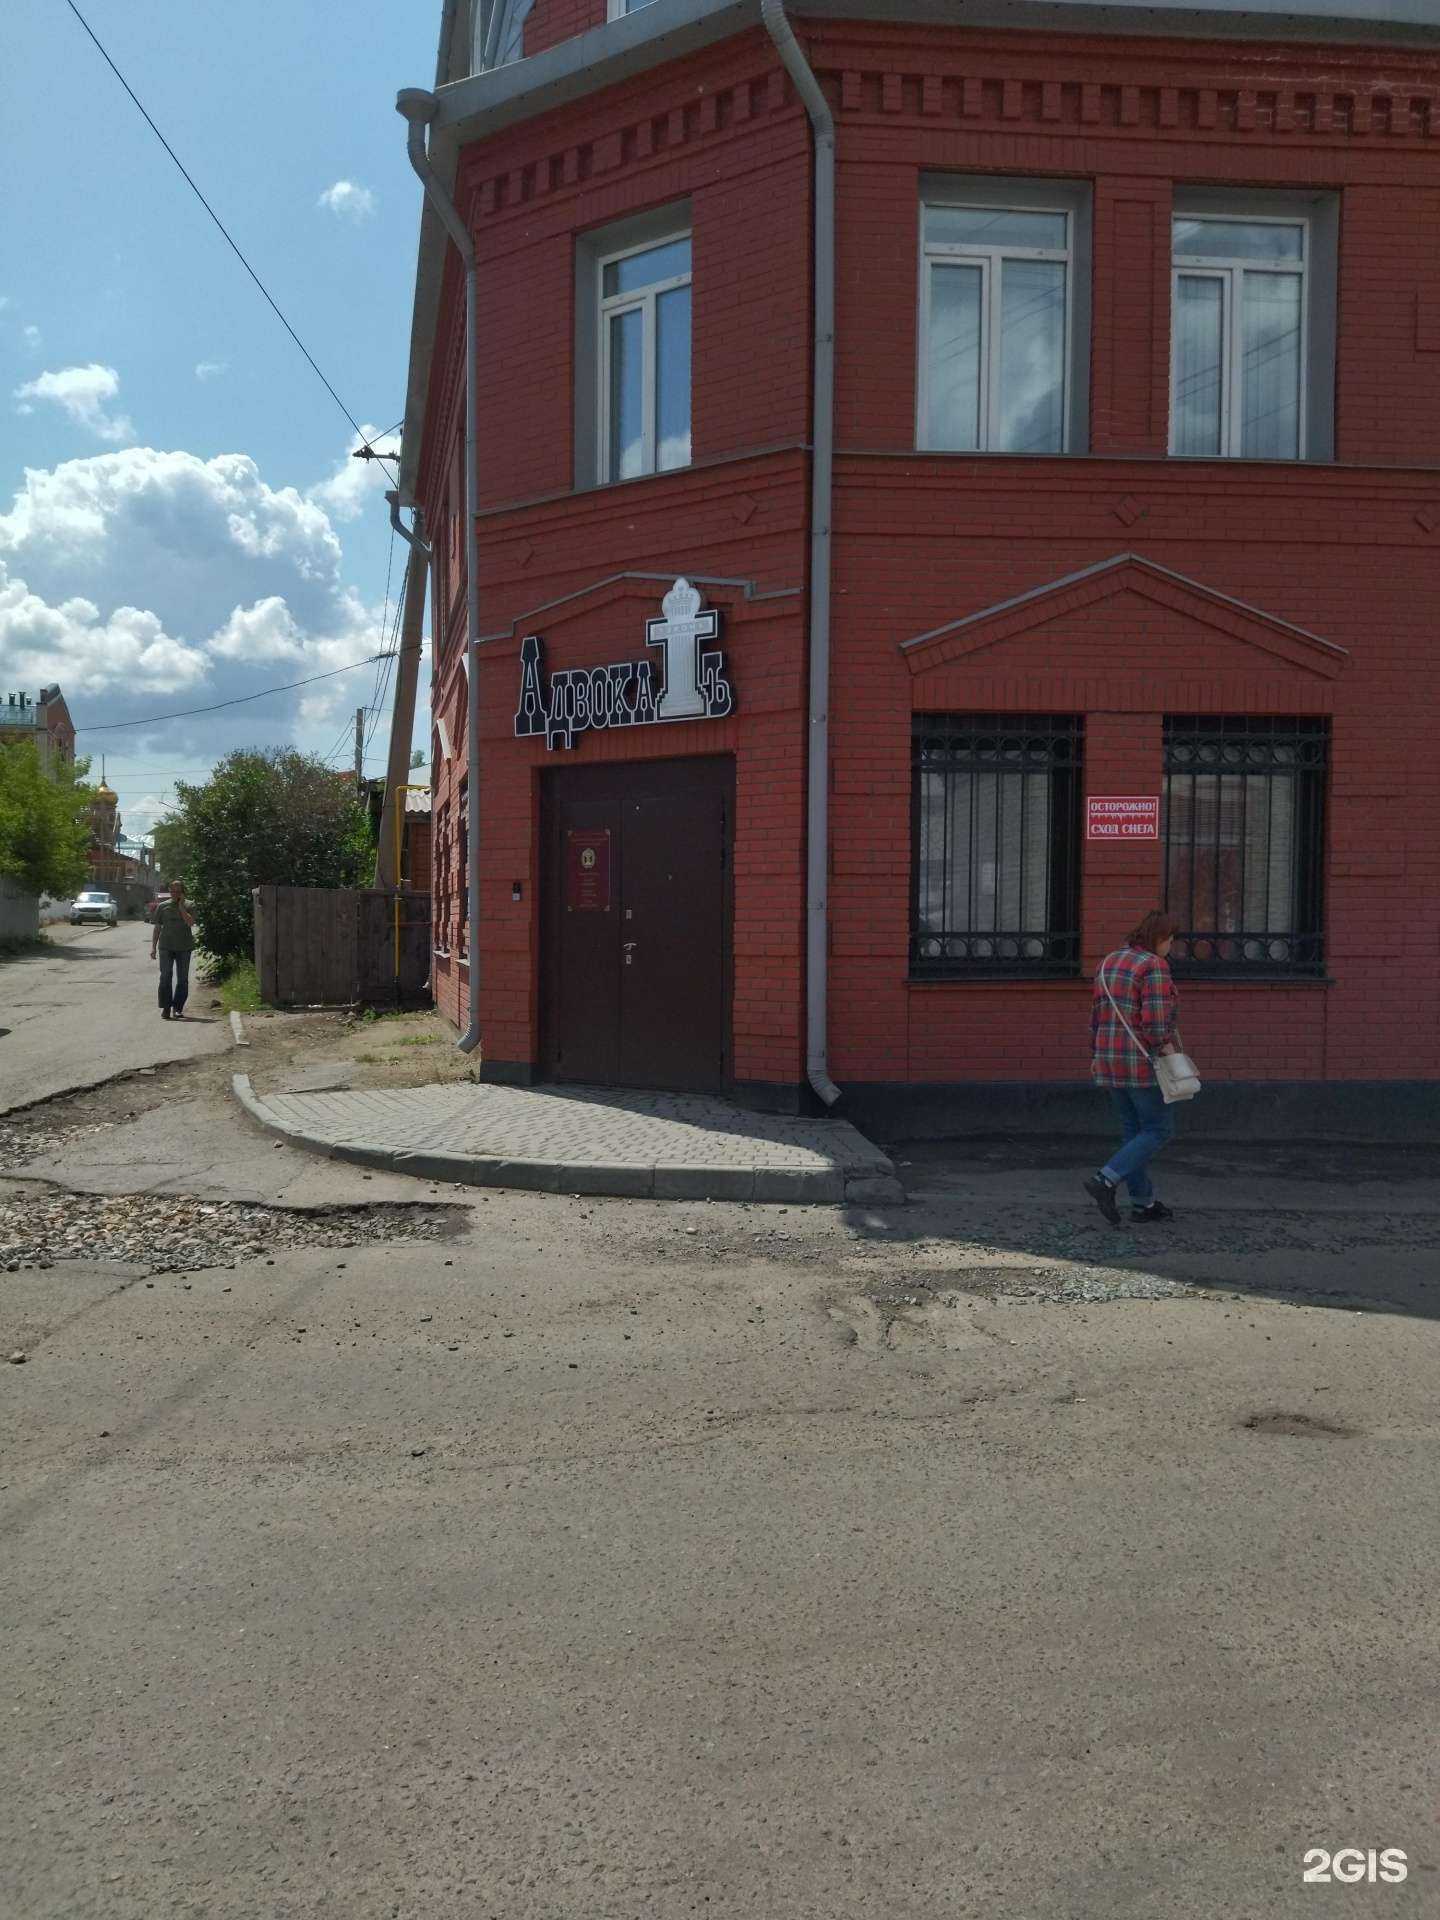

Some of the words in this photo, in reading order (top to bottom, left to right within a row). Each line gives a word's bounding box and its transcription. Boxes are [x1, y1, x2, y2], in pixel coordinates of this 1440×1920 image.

[1090, 802, 1156, 812] ОСТОРОЖНО!
[1090, 824, 1119, 834] СХОД
[1121, 824, 1154, 834] СНЕГА
